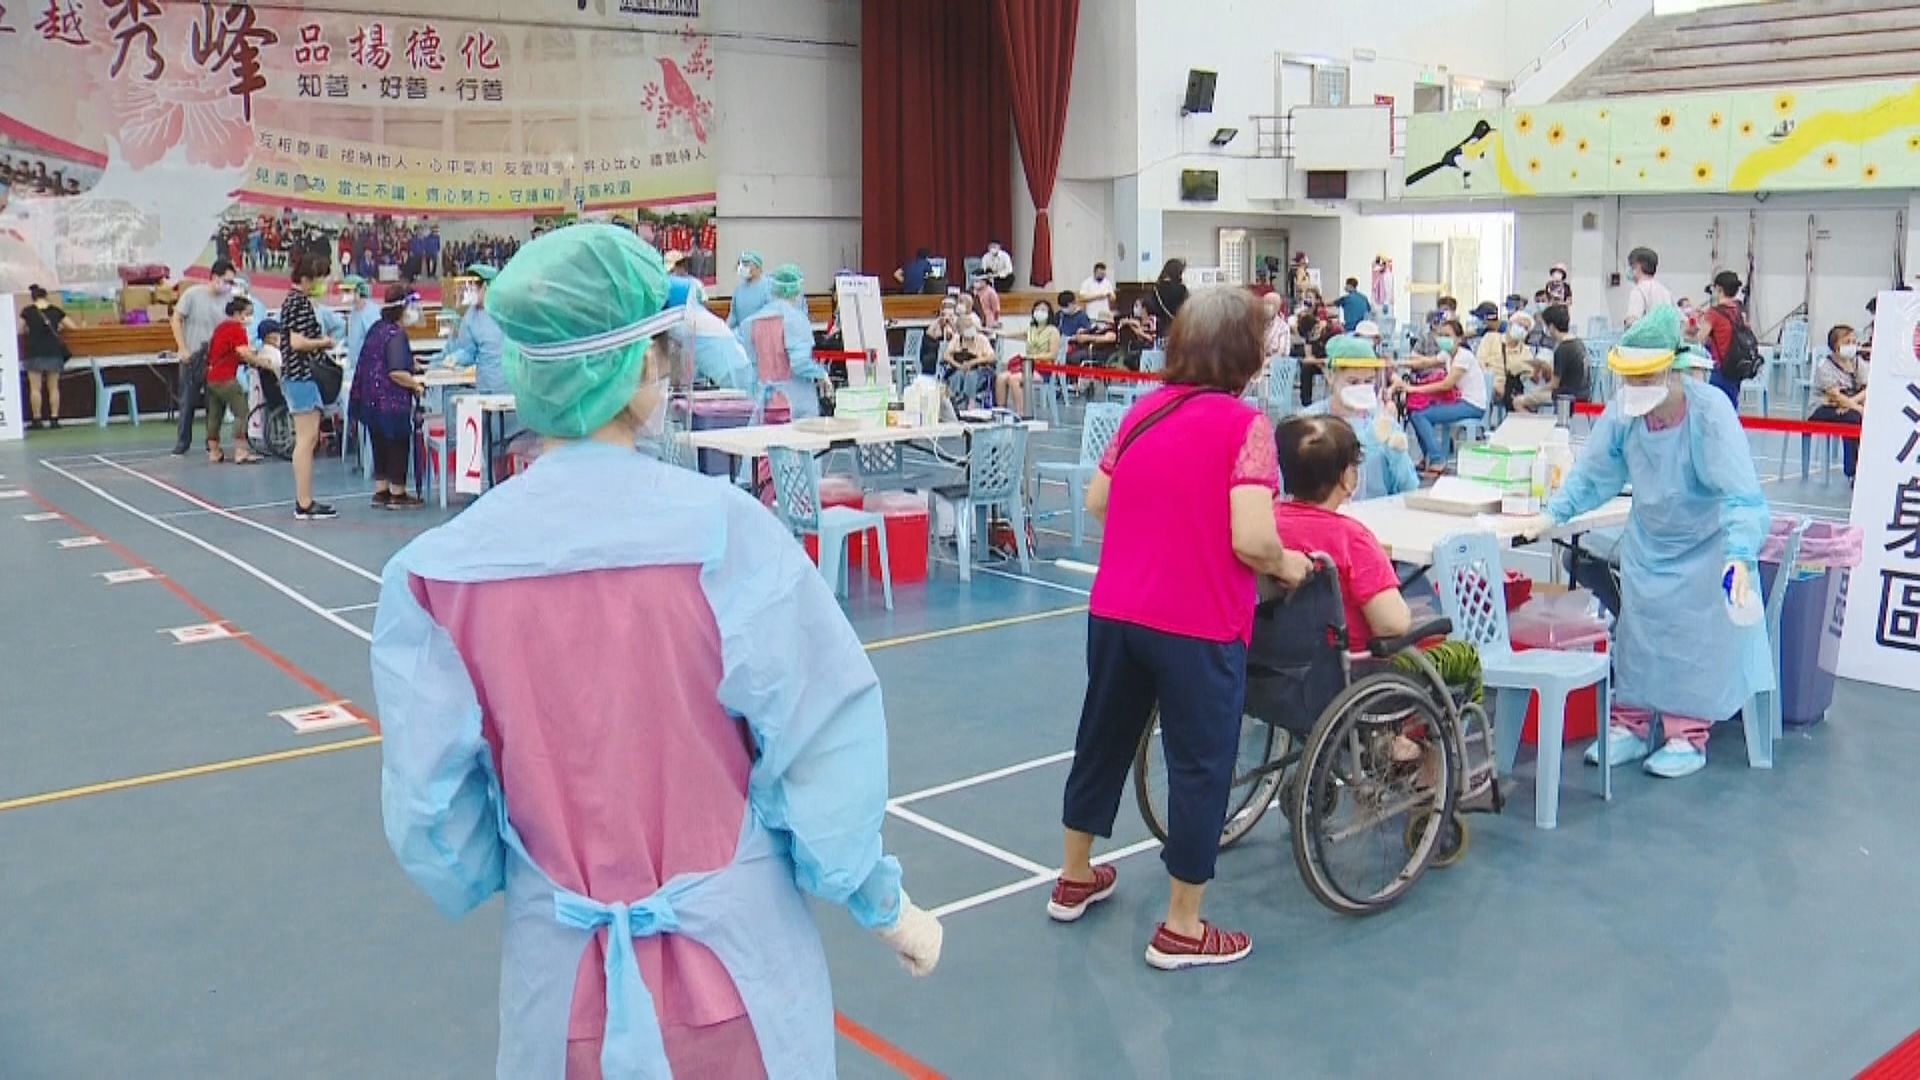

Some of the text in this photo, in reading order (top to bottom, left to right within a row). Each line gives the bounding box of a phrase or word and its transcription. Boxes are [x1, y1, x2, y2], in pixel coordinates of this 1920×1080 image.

[102, 0, 278, 122] 秀峰
[295, 23, 500, 70] 品揚德化
[464, 415, 481, 478] 2
